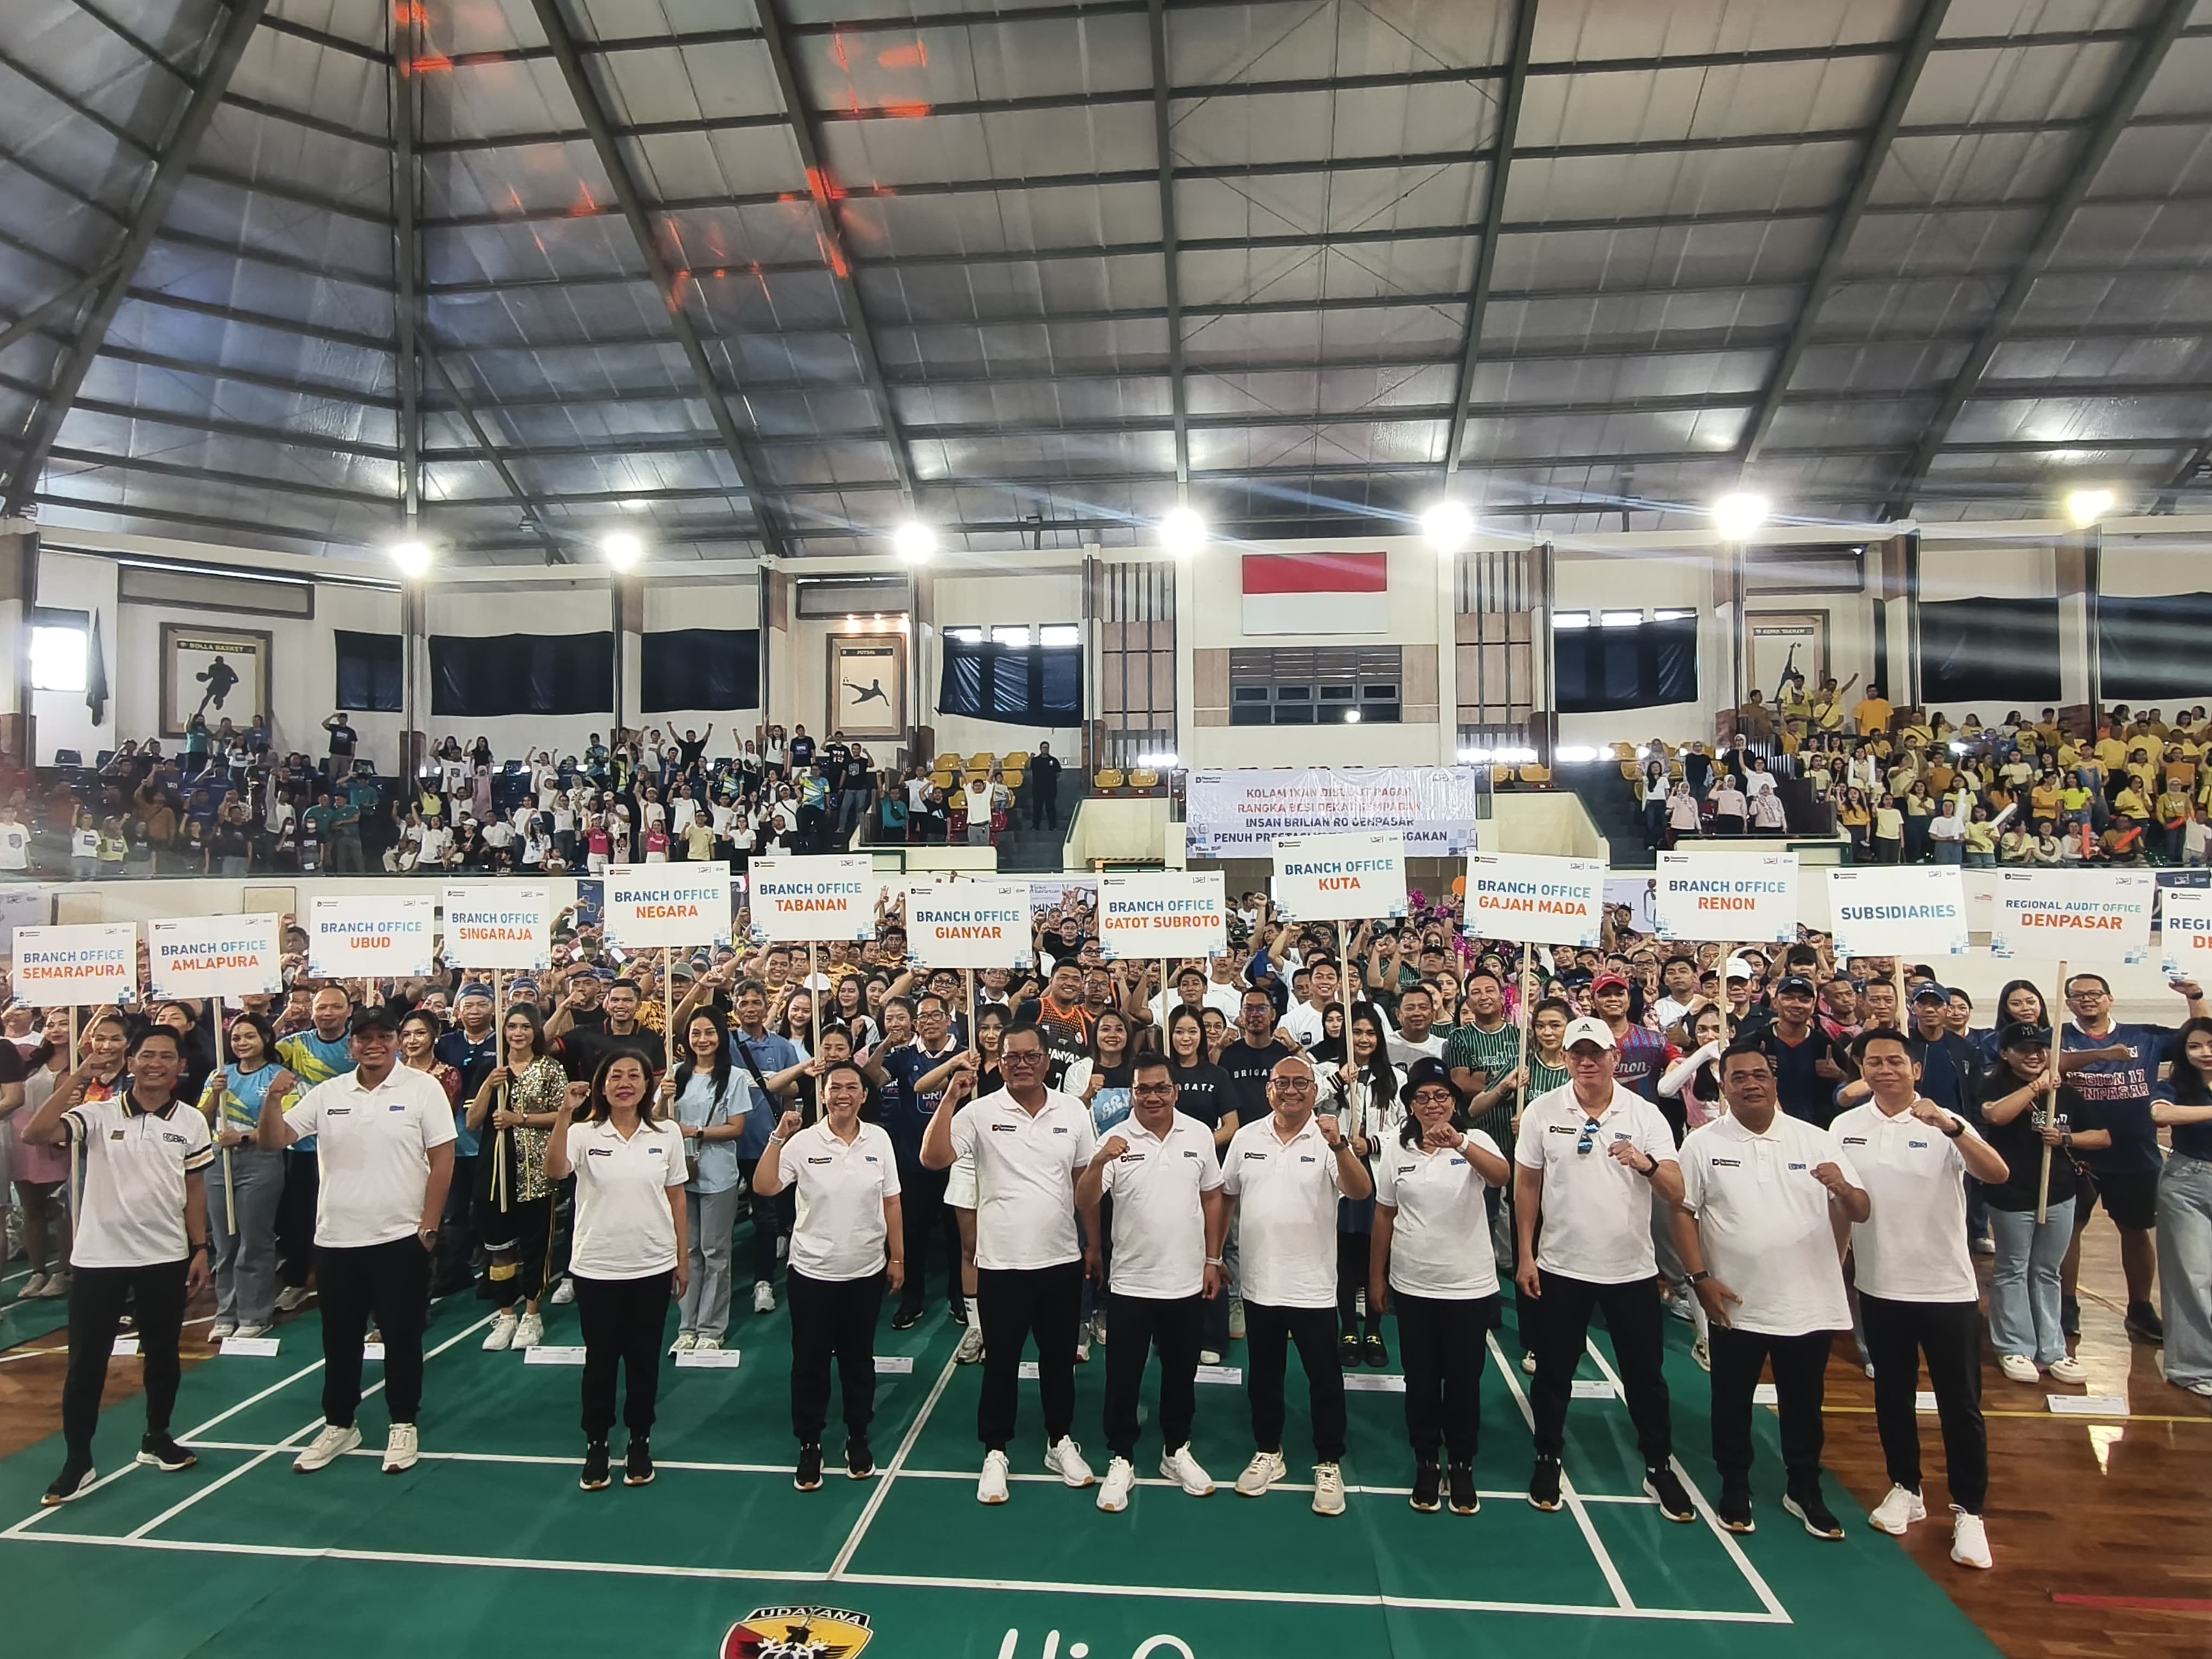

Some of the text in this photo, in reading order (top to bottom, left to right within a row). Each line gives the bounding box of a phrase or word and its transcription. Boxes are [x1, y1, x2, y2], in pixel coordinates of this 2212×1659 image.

[1247, 789, 1286, 798] KOLAM
[1238, 803, 1286, 813] RANGKA
[1246, 818, 1281, 827] INSAN
[1284, 818, 1330, 827] BRILIAN
[1334, 818, 1349, 827] RO
[1214, 833, 1252, 843] PENUH
[1285, 859, 1393, 875] BRANCH OFFICE
[760, 883, 861, 895] BRANCH OFFICE
[1319, 877, 1361, 890] KUTA
[1478, 880, 1590, 898] BRANCH OFFICE
[1669, 880, 1785, 892] BRANCH OFFICE
[615, 889, 718, 902] BRANCH OFFICE
[775, 898, 846, 911] TABANAN
[1109, 900, 1213, 912] BRANCH OFFICE
[1480, 896, 1586, 915] GAJAH MADA
[1699, 897, 1754, 910] RENON
[2006, 900, 2140, 912] REGIONAL AUDIT OFFICE
[452, 913, 538, 923] BRANCH OFFICE
[636, 905, 698, 918] NEGARA
[917, 911, 1019, 922] BRANCH OFFICE
[1841, 905, 1955, 919] SUBSIDIARIES
[321, 922, 421, 933] BRANCH OFFICE
[1105, 915, 1219, 929] GATOT SUBROTO
[2022, 914, 2122, 929] DENPASAR
[460, 928, 532, 940] SINGARAJA
[936, 927, 1001, 938] GIANYAR
[162, 941, 265, 956] BRANCH OFFICE
[351, 937, 390, 949] UBUD
[24, 950, 123, 963] BRANCH OFFICE
[172, 955, 259, 971] AMLAPURA
[23, 964, 125, 979] SEMARAPURA
[1234, 1069, 1272, 1079] BRIGA
[2128, 1069, 2145, 1083] 17
[761, 1608, 860, 1624] UDAYANA
